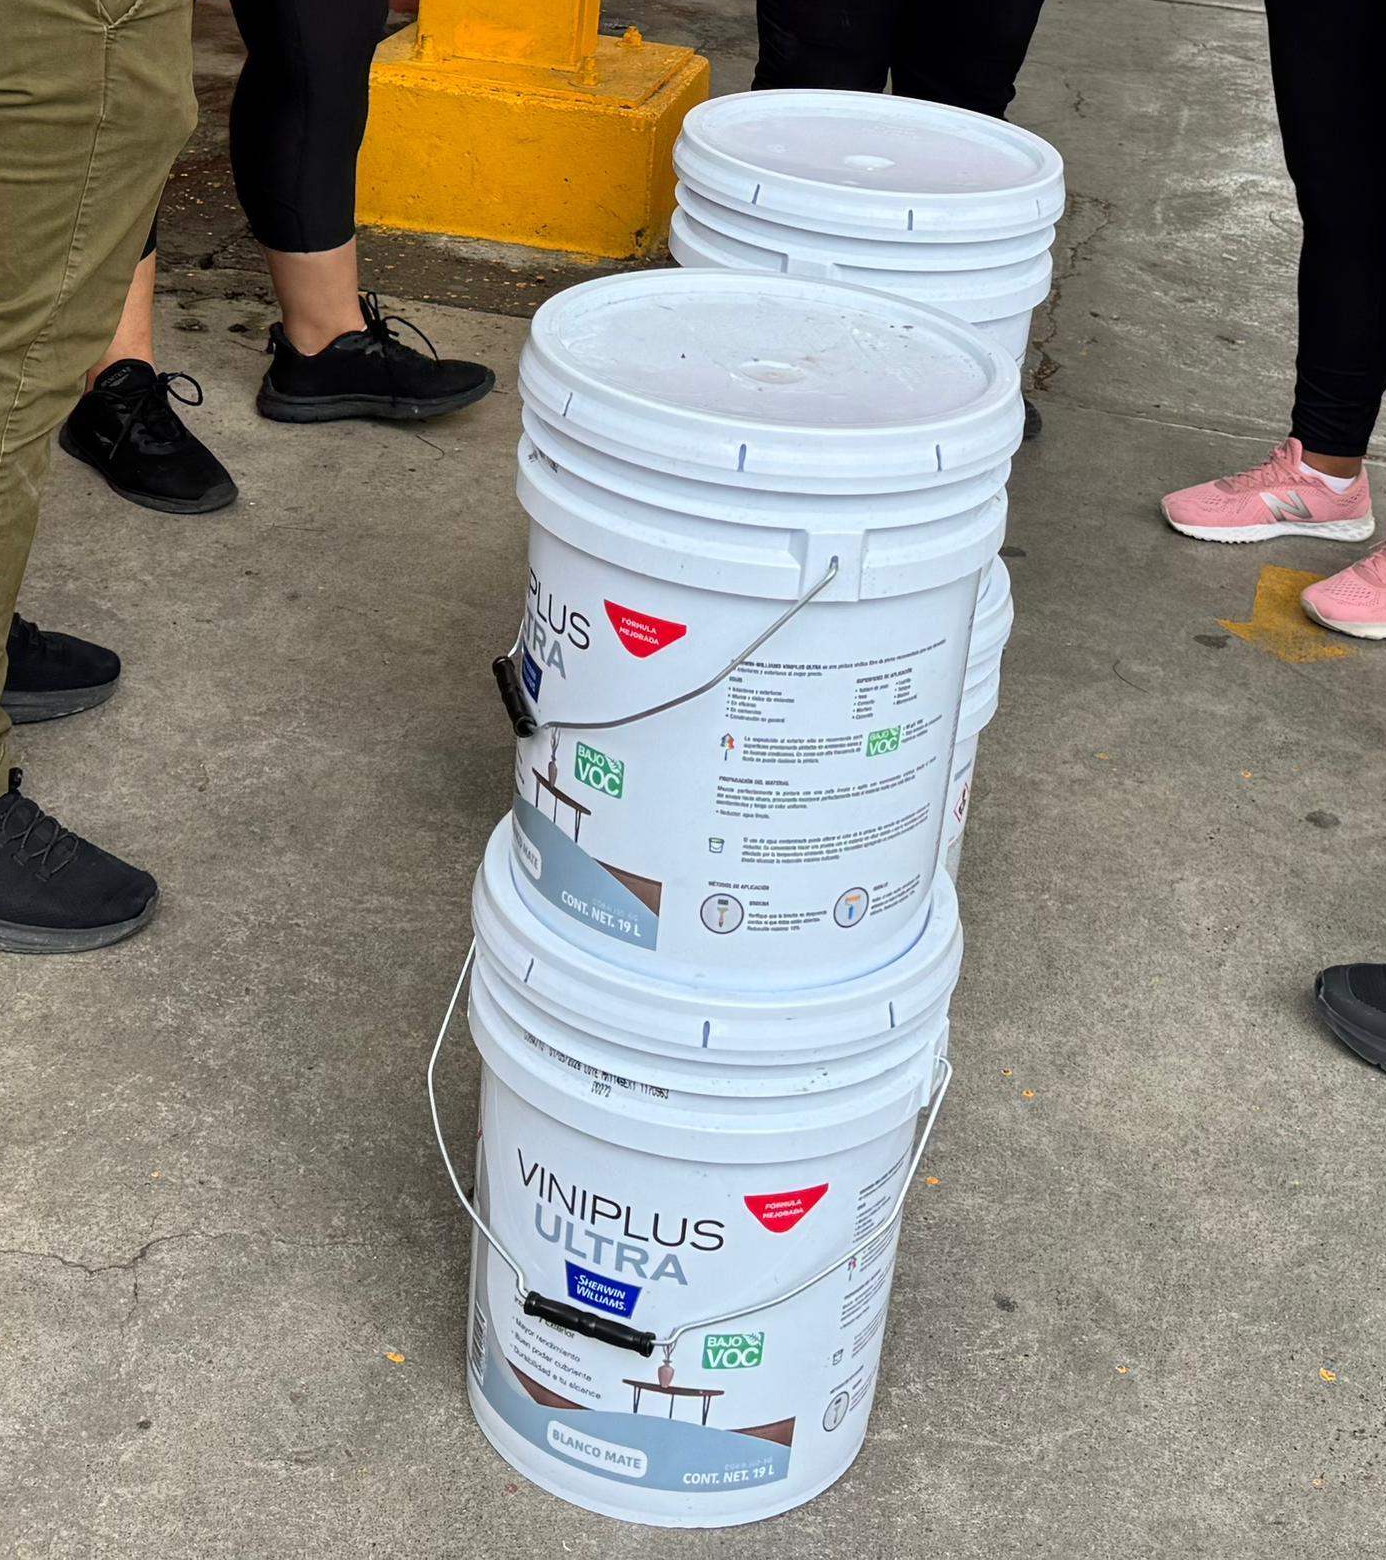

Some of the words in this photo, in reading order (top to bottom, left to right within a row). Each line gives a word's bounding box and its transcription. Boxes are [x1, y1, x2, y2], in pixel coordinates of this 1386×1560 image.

[577, 744, 606, 768] BAJO
[868, 737, 898, 755] VOC
[577, 758, 621, 796] VOC
[561, 890, 589, 915] CONT.
[591, 906, 615, 928] NET.
[618, 918, 631, 933] 19
[633, 924, 642, 937] L
[517, 1147, 725, 1251] VINIPLUS
[534, 1201, 688, 1285] ULTRA
[578, 1274, 626, 1299] SHERWIN
[514, 1331, 531, 1349] Buen
[532, 1346, 553, 1363] poder
[554, 1360, 592, 1382] cubriente
[515, 1317, 535, 1337] Mayor
[535, 1334, 581, 1362] rendimiento
[706, 1347, 759, 1368] VOC
[707, 1335, 742, 1348] BAJO
[513, 1345, 551, 1377] Durabilidad
[559, 1377, 567, 1386] tu
[569, 1382, 601, 1400] alcance
[552, 1429, 601, 1458] BLANCO
[605, 1451, 642, 1470] MATE
[682, 1472, 720, 1485] CONT.
[723, 1469, 749, 1483] NET.
[752, 1466, 766, 1479] 19
[768, 1464, 774, 1476] L
